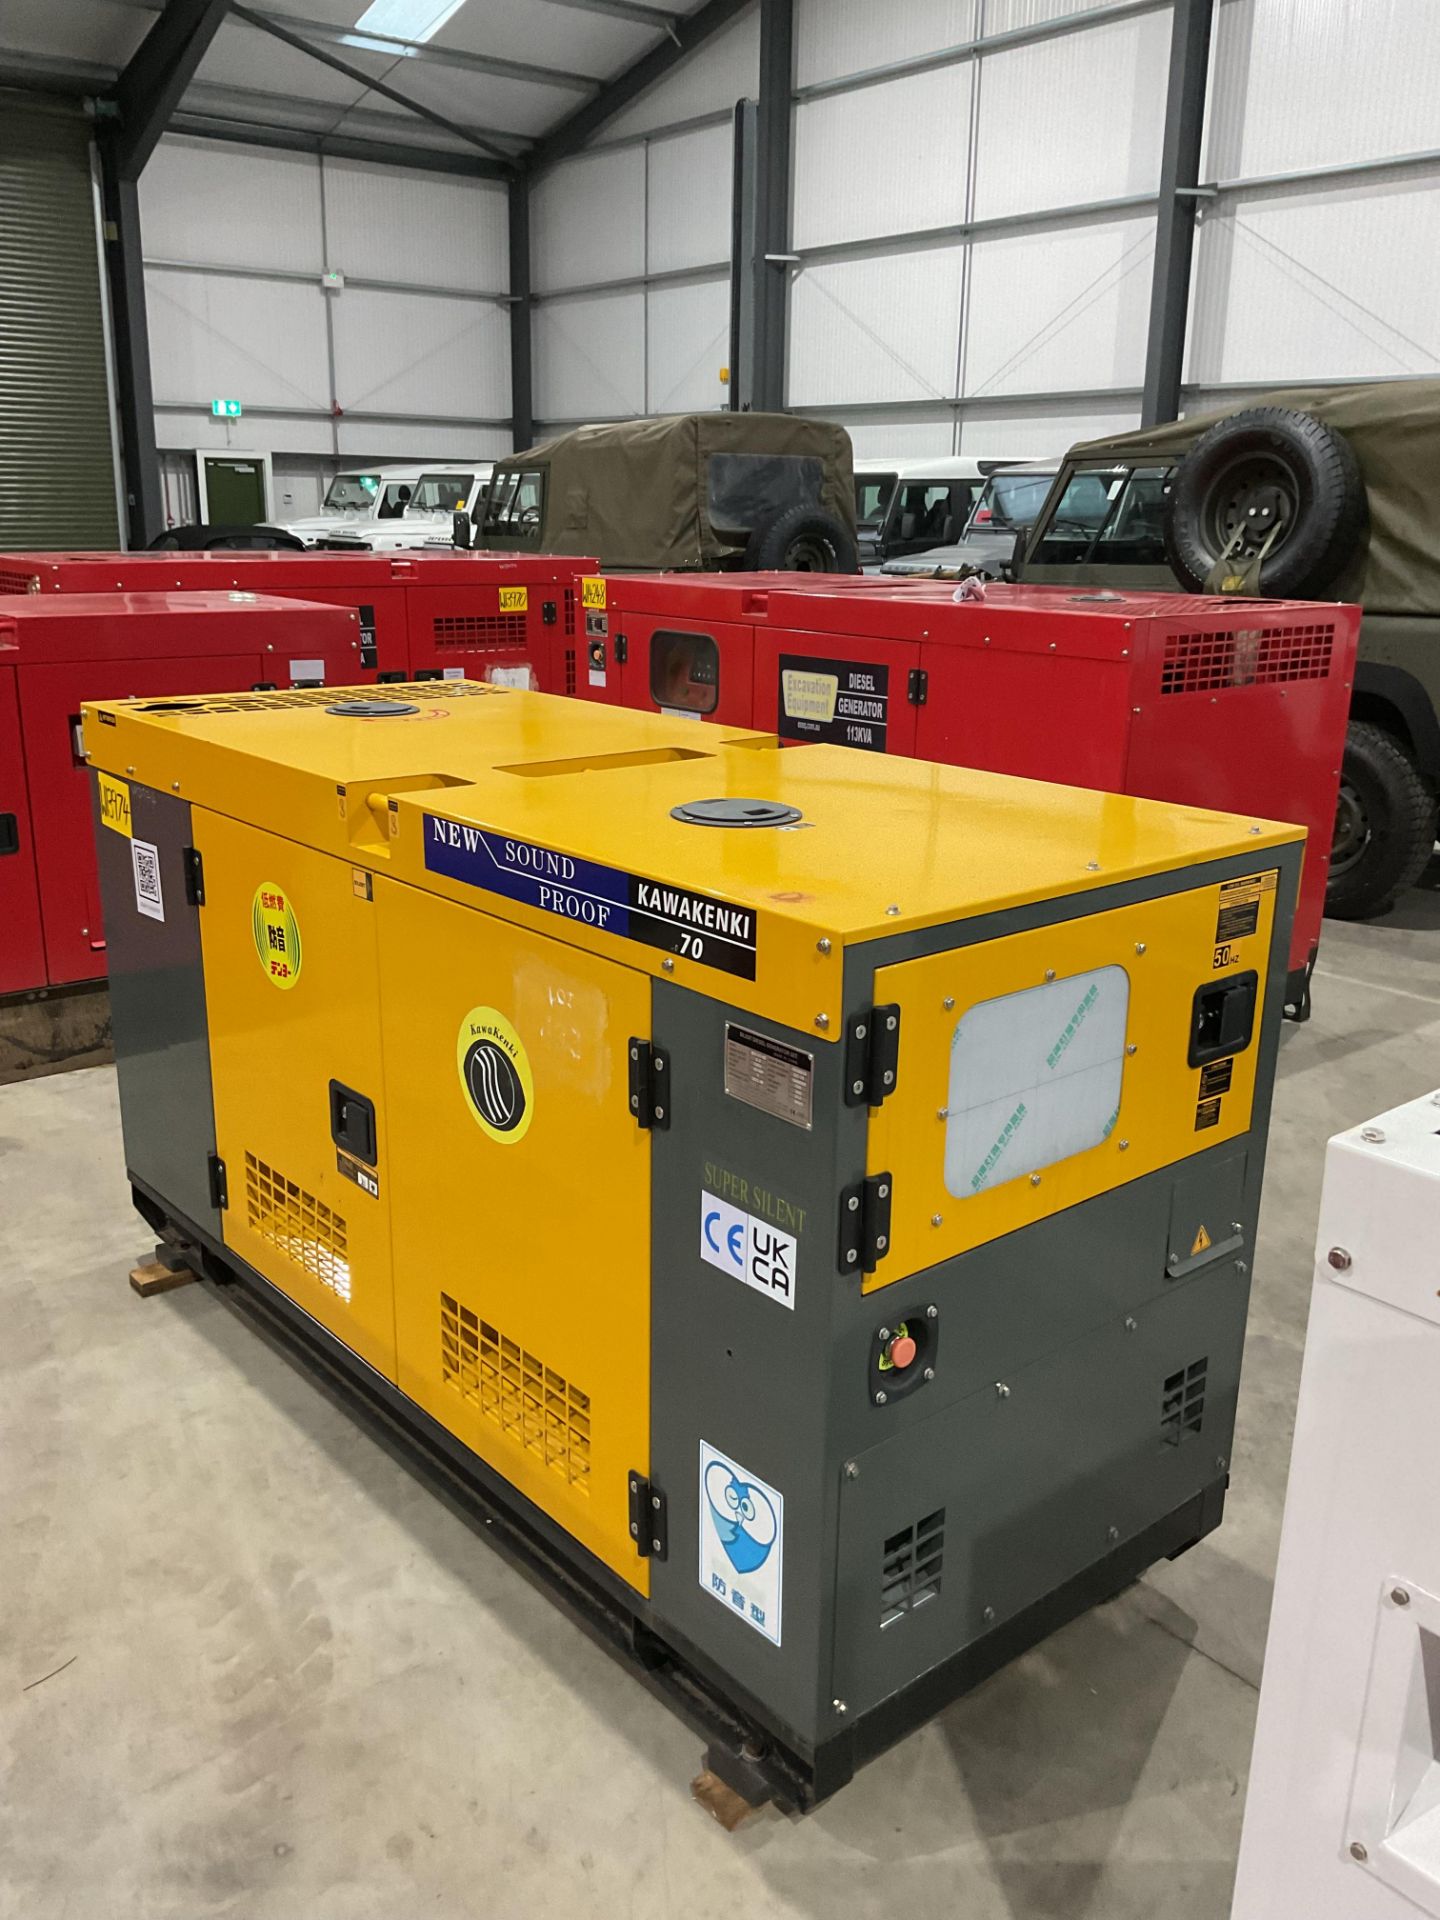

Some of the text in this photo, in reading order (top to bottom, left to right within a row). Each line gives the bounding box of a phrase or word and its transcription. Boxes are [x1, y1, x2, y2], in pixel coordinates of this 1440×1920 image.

[787, 674, 832, 697] Excavation
[848, 672, 875, 691] DIESEL
[787, 693, 830, 716] Equipment
[838, 697, 883, 719] GENERATOR
[846, 725, 873, 744] 113KVA
[432, 817, 480, 853] NEW
[505, 840, 576, 880] SOUND
[538, 885, 611, 928] PROOF
[637, 883, 750, 939] KAWAKENKI
[680, 932, 704, 959] 70
[703, 1161, 807, 1232] SUPER SILENT
[704, 1211, 744, 1266] CE
[753, 1226, 790, 1269] UK
[752, 1256, 789, 1297] CA
